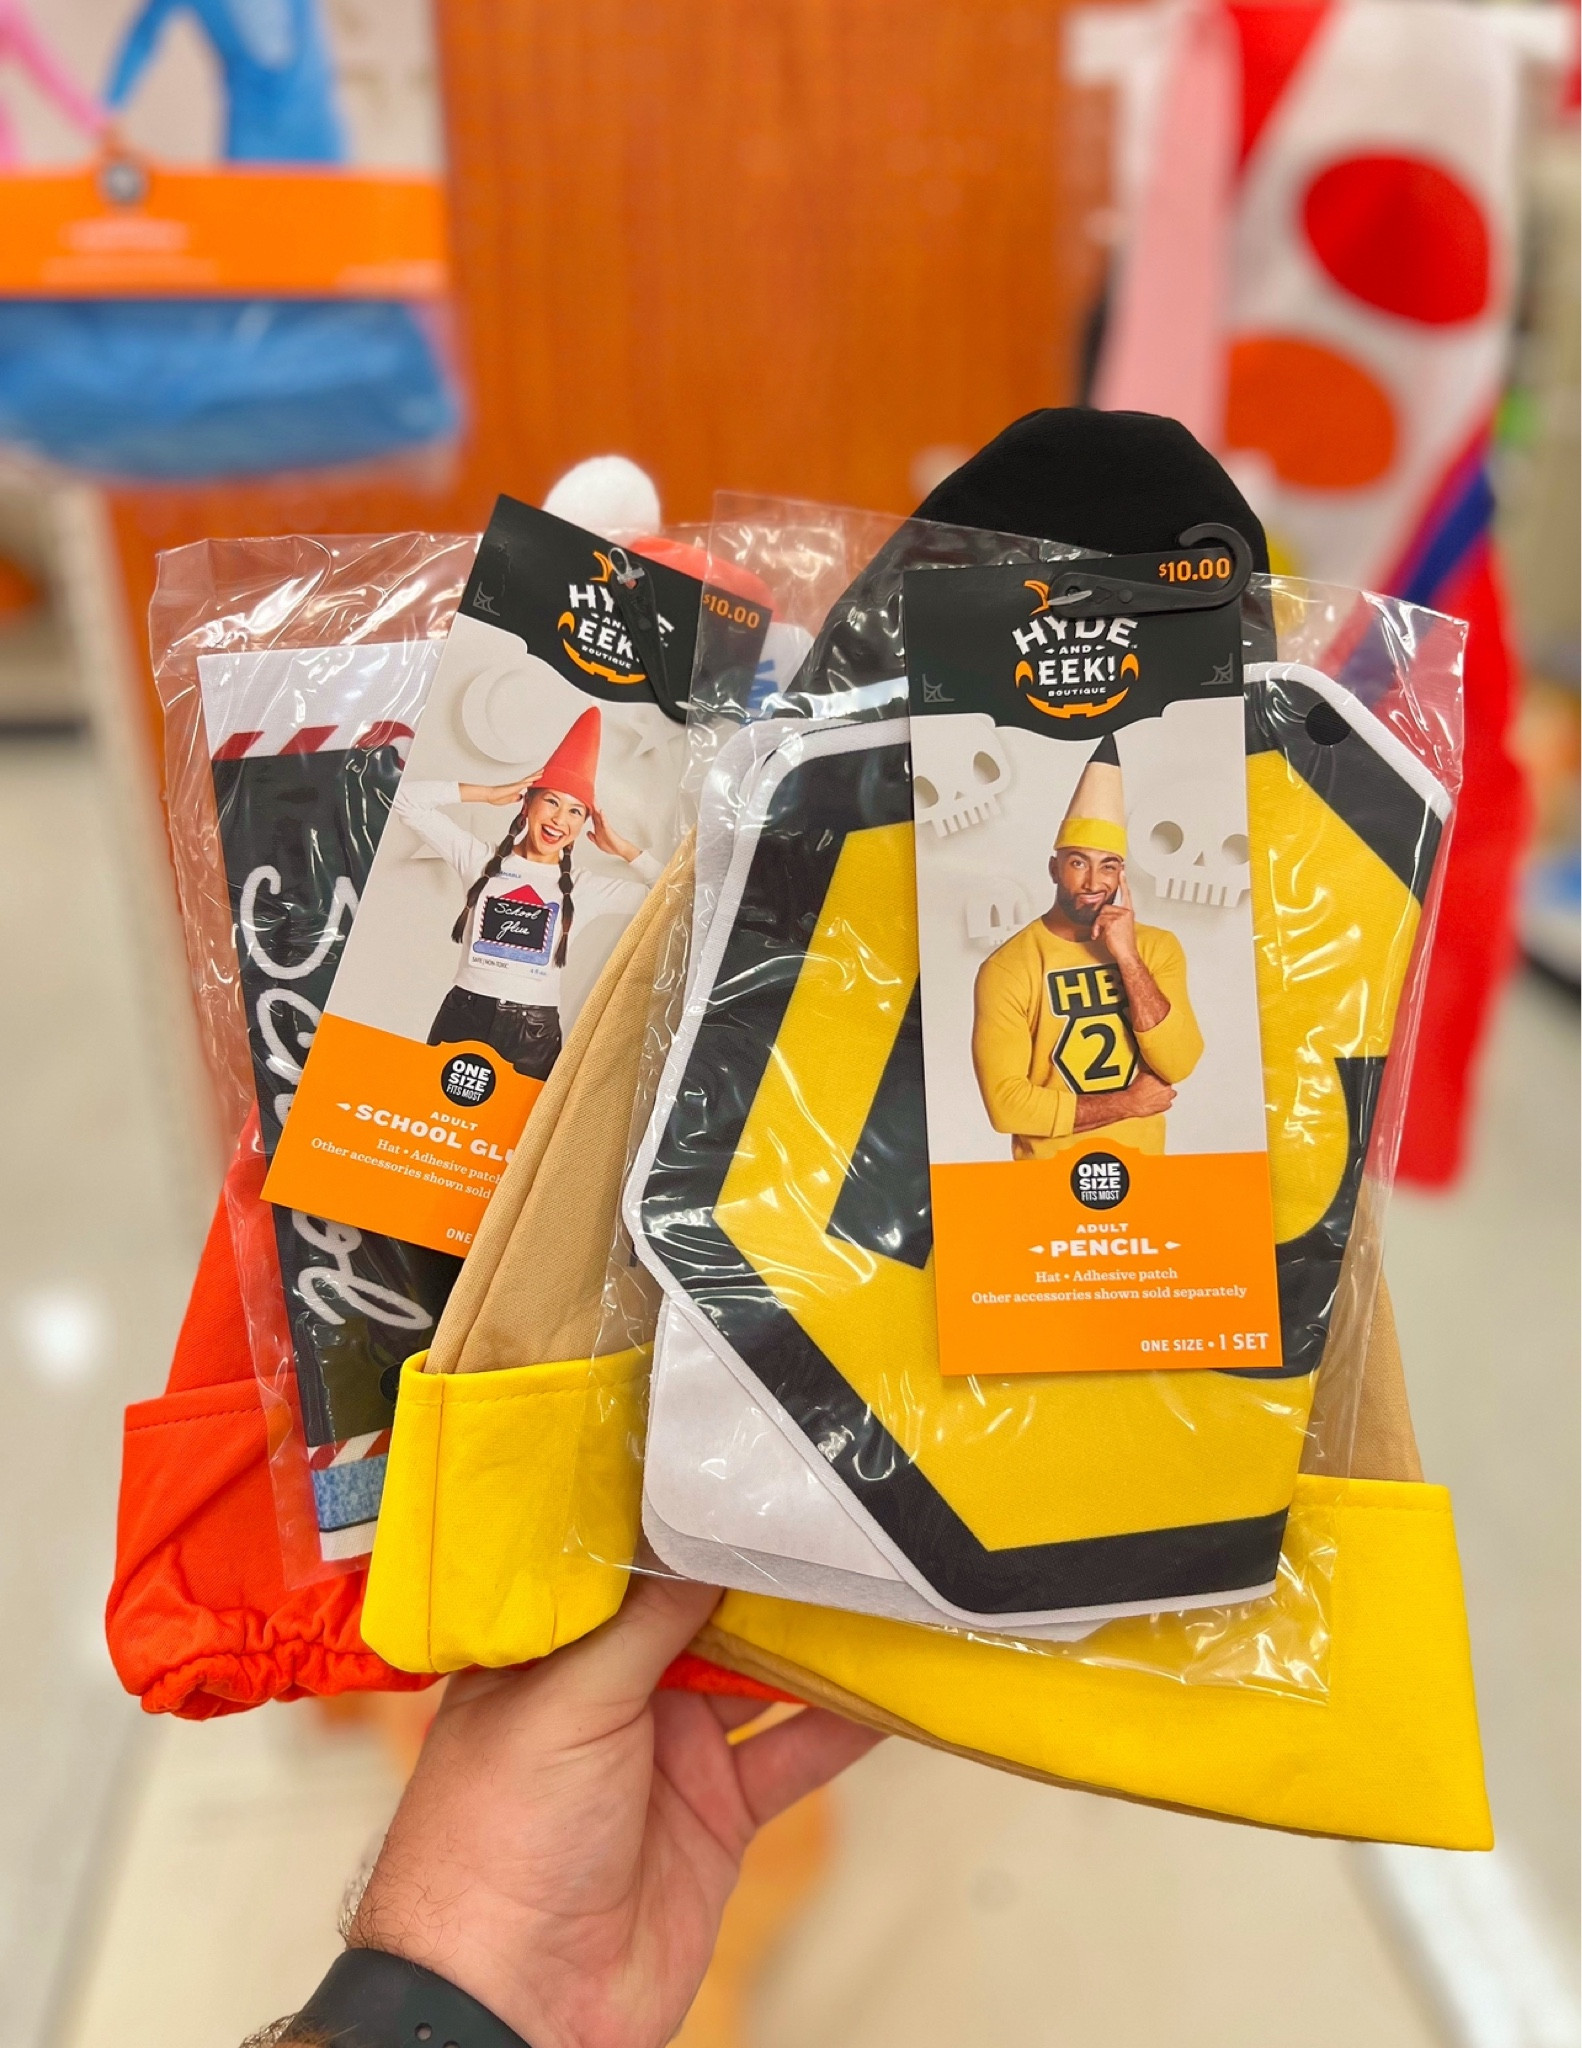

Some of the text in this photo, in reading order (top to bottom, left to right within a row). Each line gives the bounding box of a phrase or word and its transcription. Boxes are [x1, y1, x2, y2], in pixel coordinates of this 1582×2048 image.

[1159, 558, 1231, 583] $10.00
[703, 593, 760, 629] $10.00
[1012, 616, 1138, 655] HYDE
[581, 645, 632, 669] BOUTIQUE
[1059, 645, 1092, 655] AND
[1038, 655, 1117, 686] EEK!
[1048, 687, 1107, 697] BOUTIQUE
[494, 902, 542, 920] School
[496, 920, 530, 941] Glue
[1080, 1023, 1121, 1080] 2
[452, 1059, 492, 1082] ONE
[446, 1083, 483, 1102] FITS MOST
[447, 1072, 488, 1093] SIZE
[430, 1111, 479, 1131] ADULT
[355, 1104, 515, 1164] SCHOOL GLU
[376, 1138, 401, 1155] Hat
[410, 1149, 468, 1175] Adhesive
[311, 1137, 492, 1200] Other accessories shown sold
[1078, 1162, 1121, 1177] ONE
[1079, 1177, 1121, 1191] SIZE
[1081, 1189, 1120, 1202] FITS MOST
[446, 1228, 473, 1244] ONE
[1076, 1222, 1129, 1234] ADULT
[1050, 1238, 1159, 1258] PENCIL
[1035, 1267, 1178, 1283] Hat Adhesive patch
[972, 1284, 1248, 1305] Other accessories shown sold separately
[1141, 1332, 1269, 1352] ONE SIZE 1 SET
